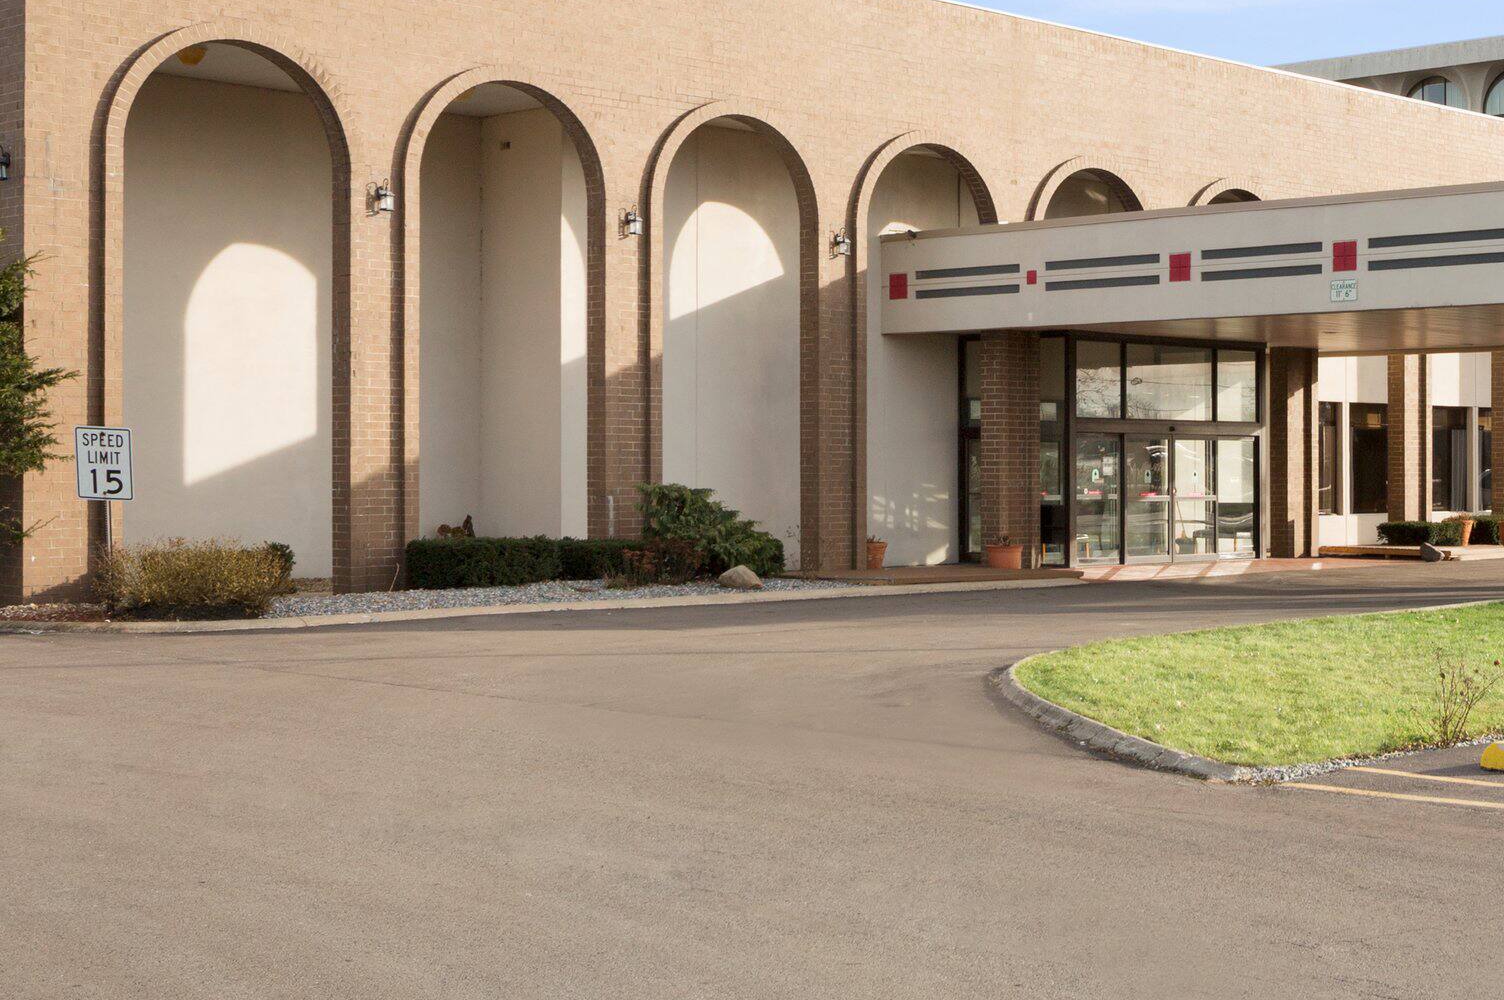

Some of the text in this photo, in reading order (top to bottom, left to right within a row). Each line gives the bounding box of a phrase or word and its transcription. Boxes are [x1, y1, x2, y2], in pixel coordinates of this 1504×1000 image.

[82, 433, 124, 448] SPEED
[88, 450, 121, 465] LIMIT
[90, 468, 124, 495] 15
